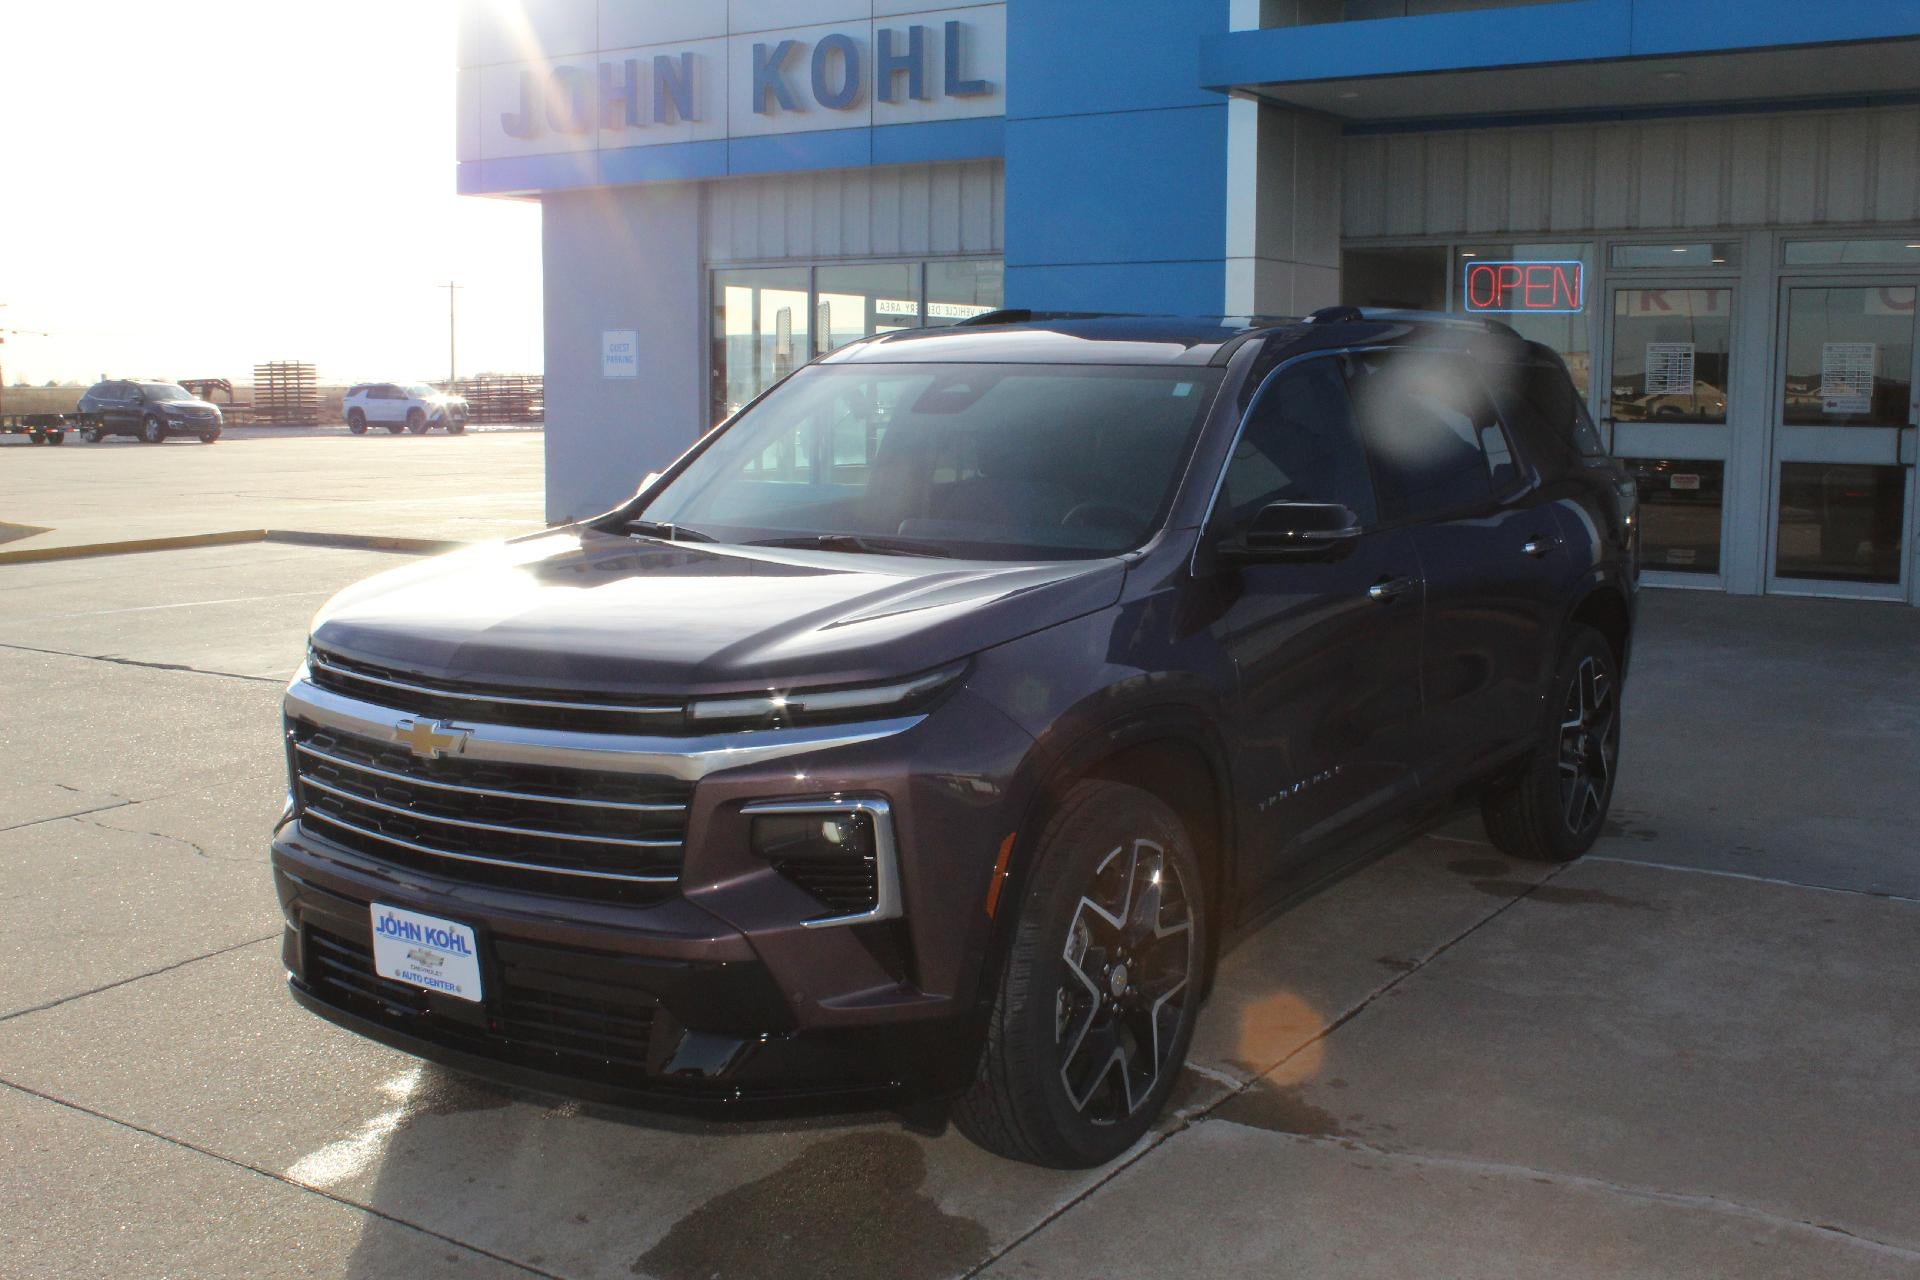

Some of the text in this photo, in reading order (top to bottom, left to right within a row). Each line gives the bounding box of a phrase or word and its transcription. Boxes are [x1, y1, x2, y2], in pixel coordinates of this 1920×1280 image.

[500, 20, 989, 139] JOHN KOHL
[1470, 265, 1580, 308] OPEN
[376, 915, 472, 955] JOHN KOHL
[402, 971, 455, 992] AUTO CENTER
